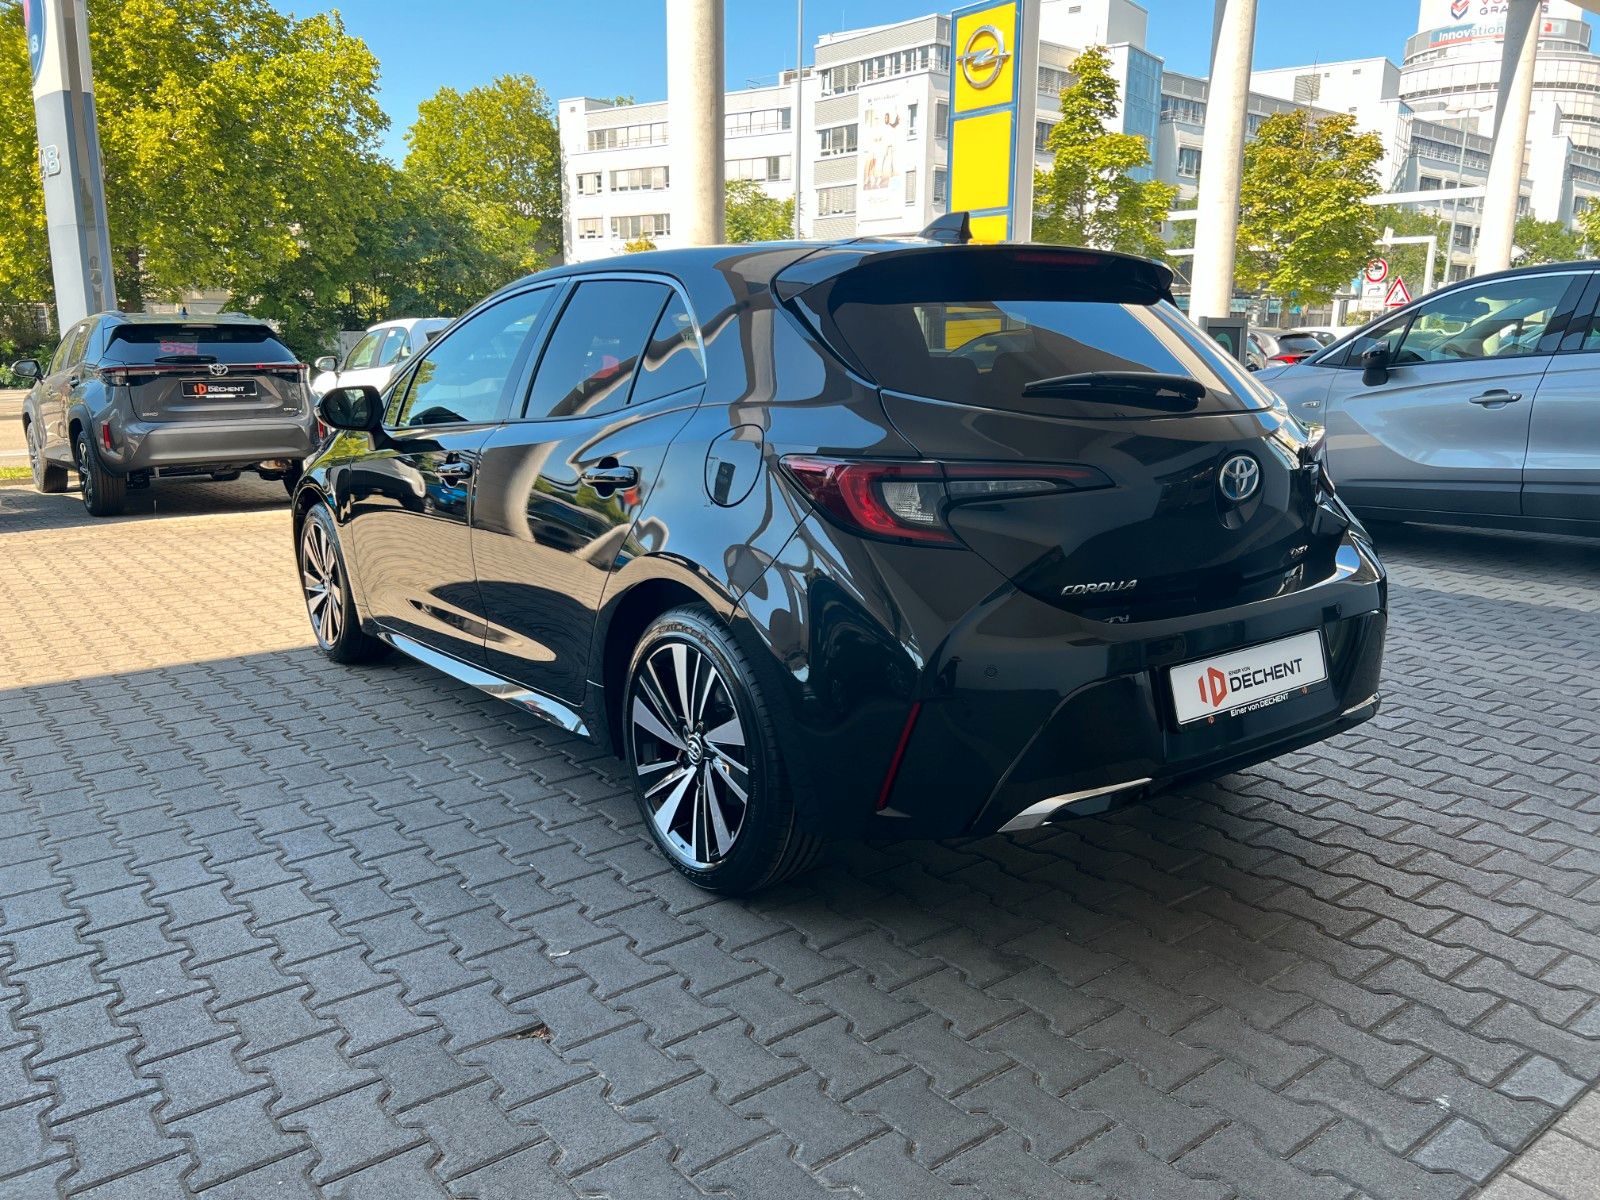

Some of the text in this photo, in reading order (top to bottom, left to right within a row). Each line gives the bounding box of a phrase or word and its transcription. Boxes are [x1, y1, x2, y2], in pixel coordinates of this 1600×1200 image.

[1060, 579, 1138, 597] COROLLA
[1228, 668, 1241, 676] EINER
[1229, 658, 1303, 693] DECHENT
[1230, 693, 1289, 717] Einer von DECHENT
